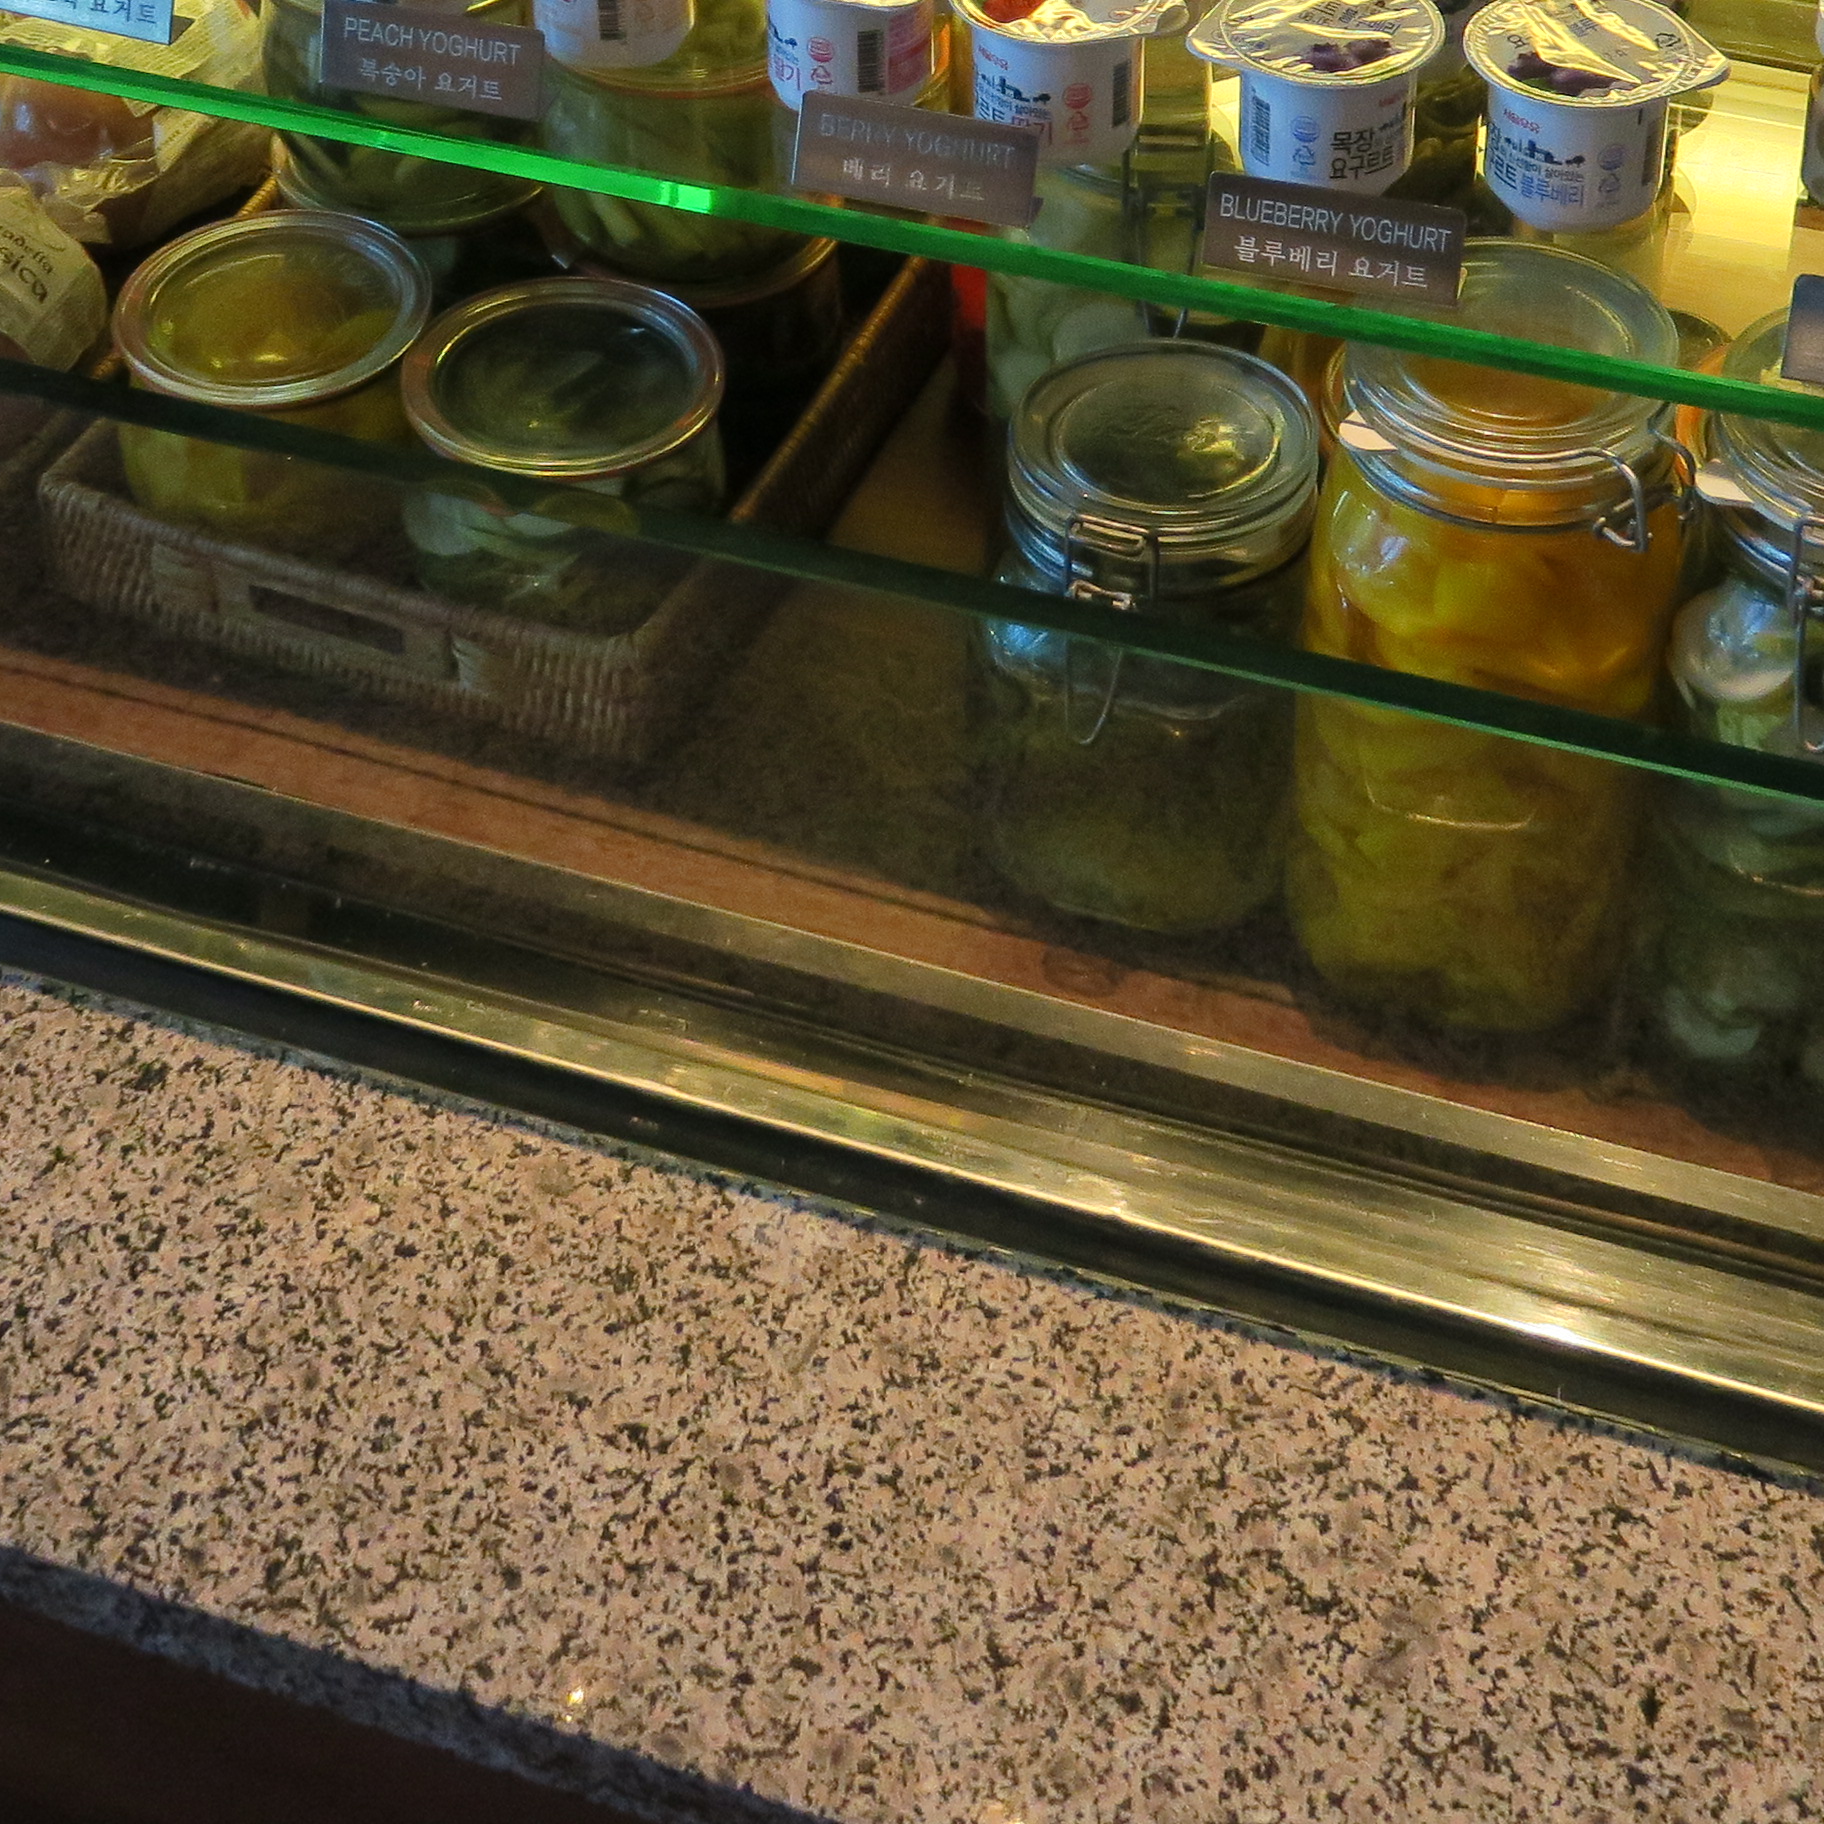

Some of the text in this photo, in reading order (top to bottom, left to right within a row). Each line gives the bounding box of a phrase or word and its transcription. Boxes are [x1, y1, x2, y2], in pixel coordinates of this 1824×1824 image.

[343, 17, 522, 66] PEACH YOGHURT
[359, 57, 503, 101] 복숭아 요거트
[904, 130, 1017, 170] YOGHURT
[1330, 129, 1376, 154] 목장
[1330, 146, 1395, 179] 요구르트
[1219, 193, 1453, 254] BLUEBERRY YOGHURT
[1234, 235, 1428, 288] 블루베리 요거트
